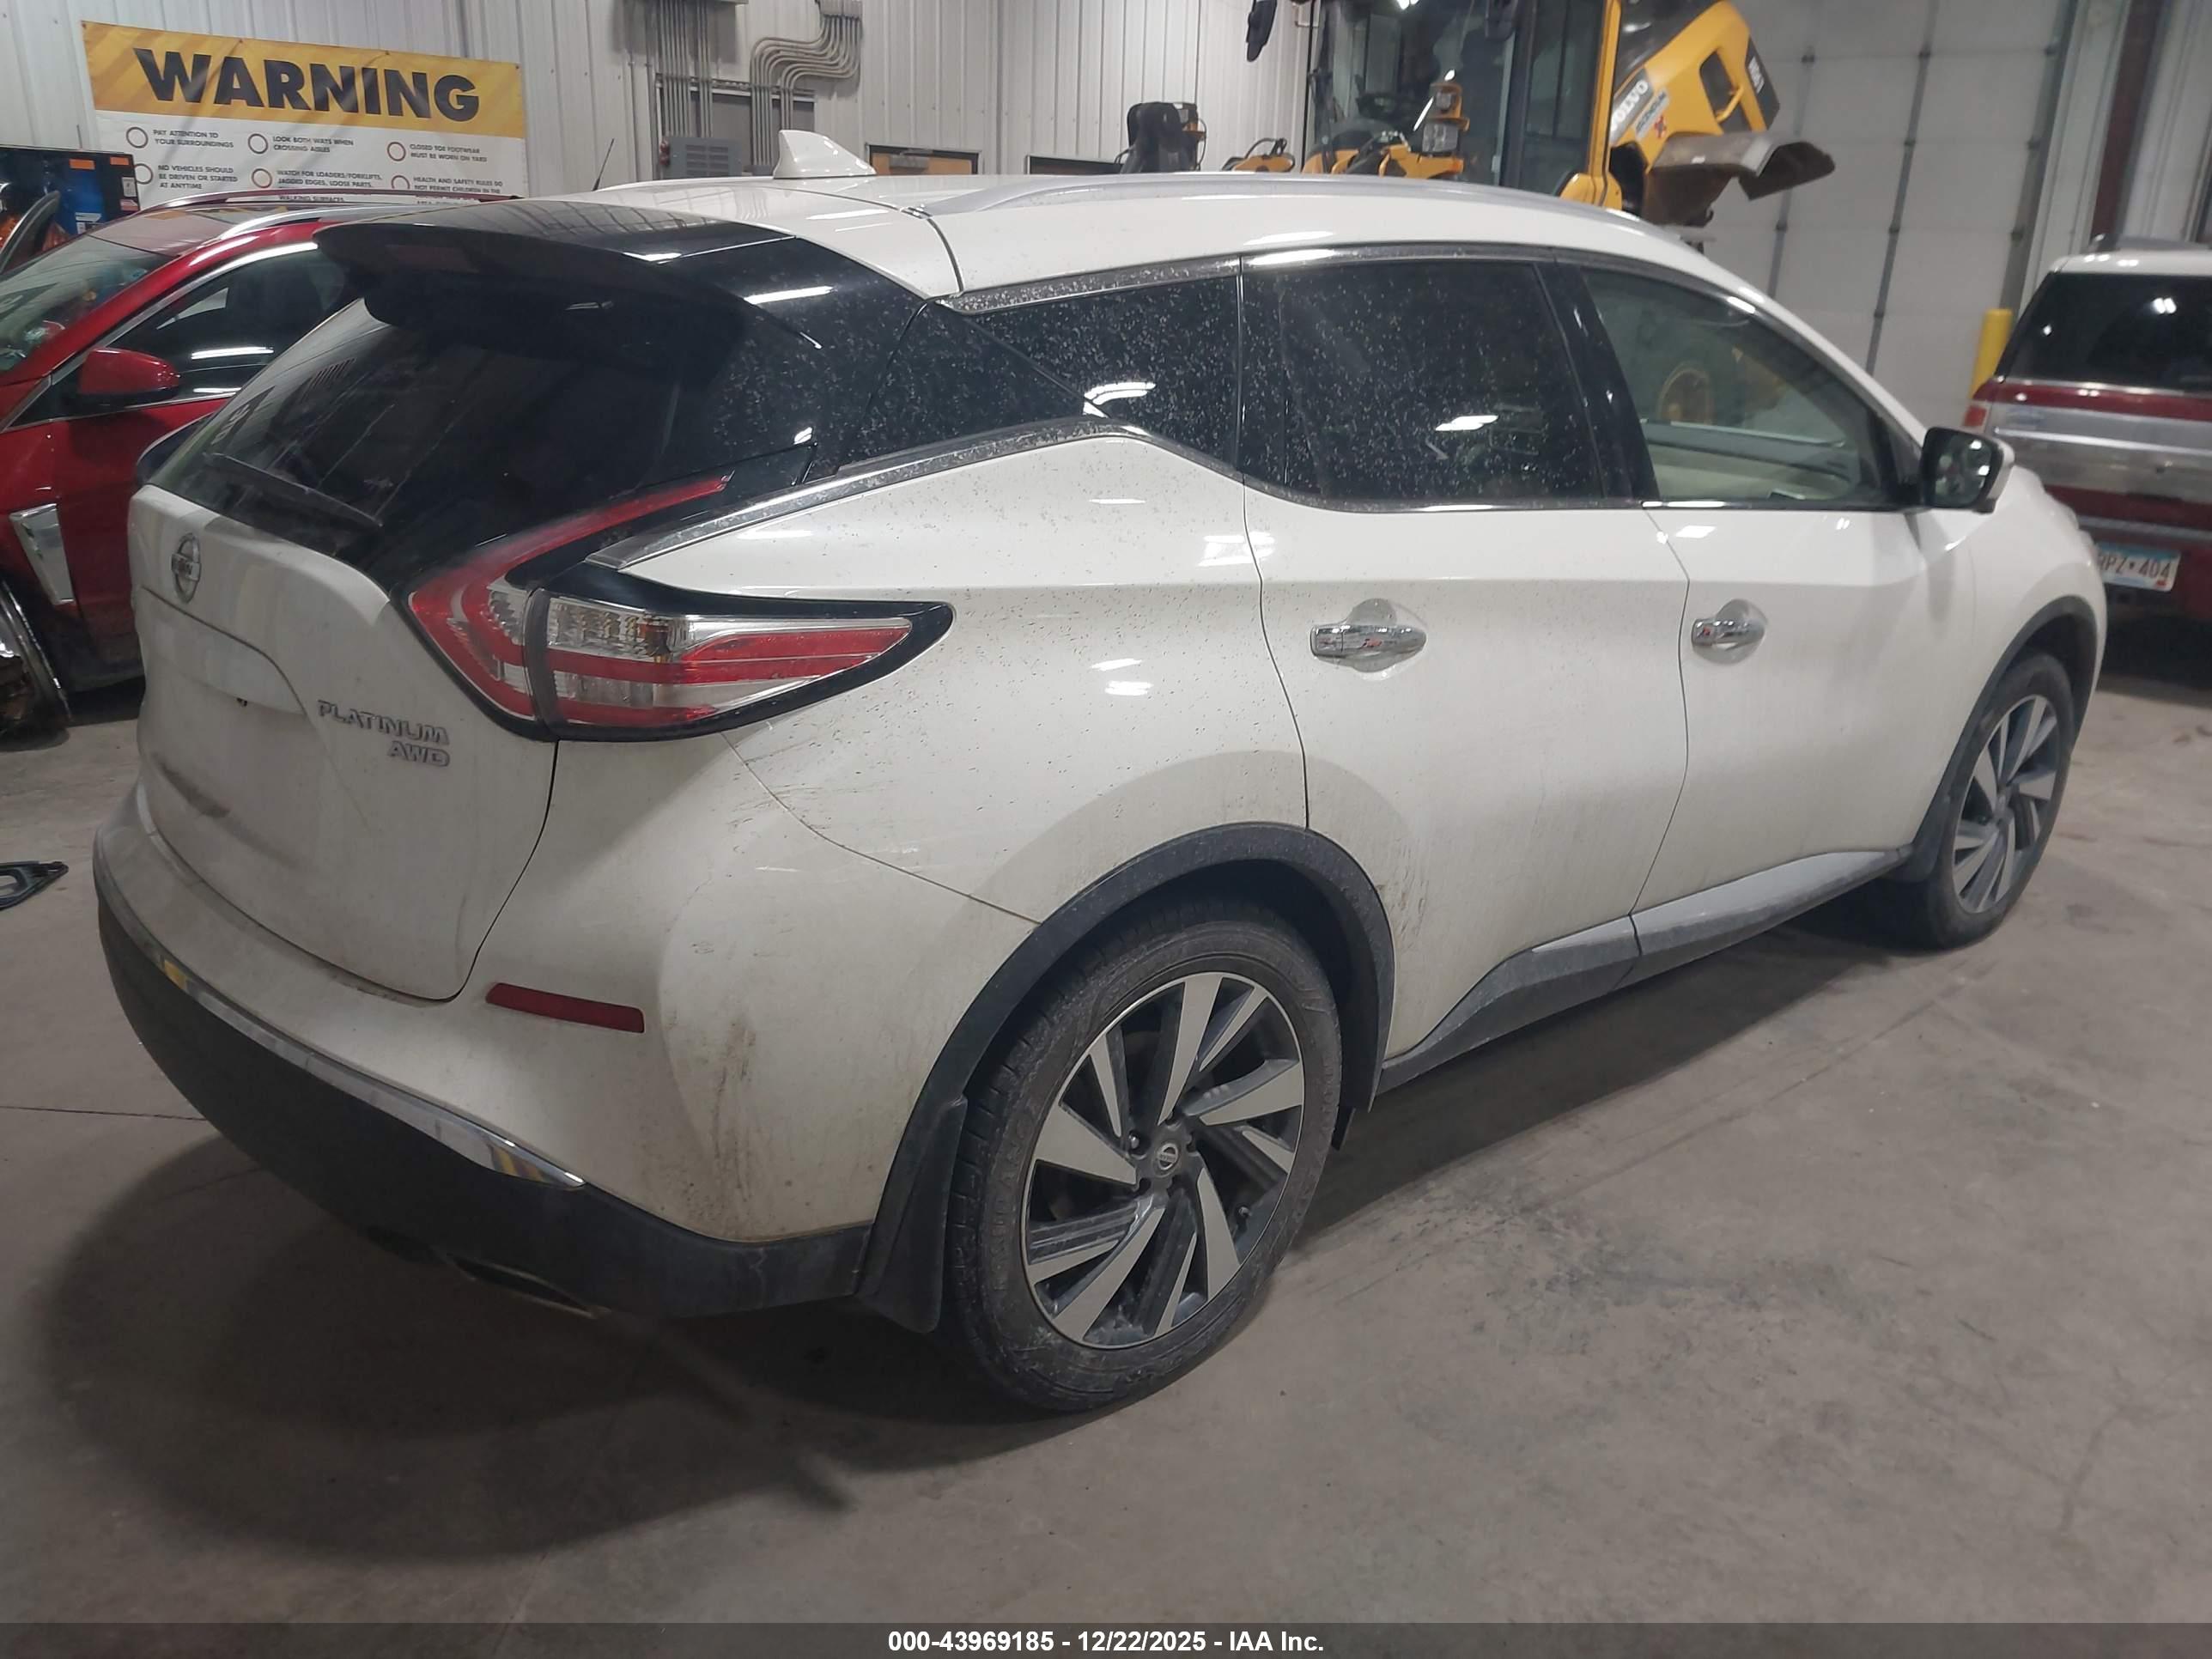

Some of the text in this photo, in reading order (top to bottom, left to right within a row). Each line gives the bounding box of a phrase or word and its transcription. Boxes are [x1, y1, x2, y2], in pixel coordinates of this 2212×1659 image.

[132, 48, 479, 122] WARNING
[177, 139, 234, 149] SURROUNDINGS
[318, 699, 450, 745] PLATINUM
[387, 740, 450, 767] AWD
